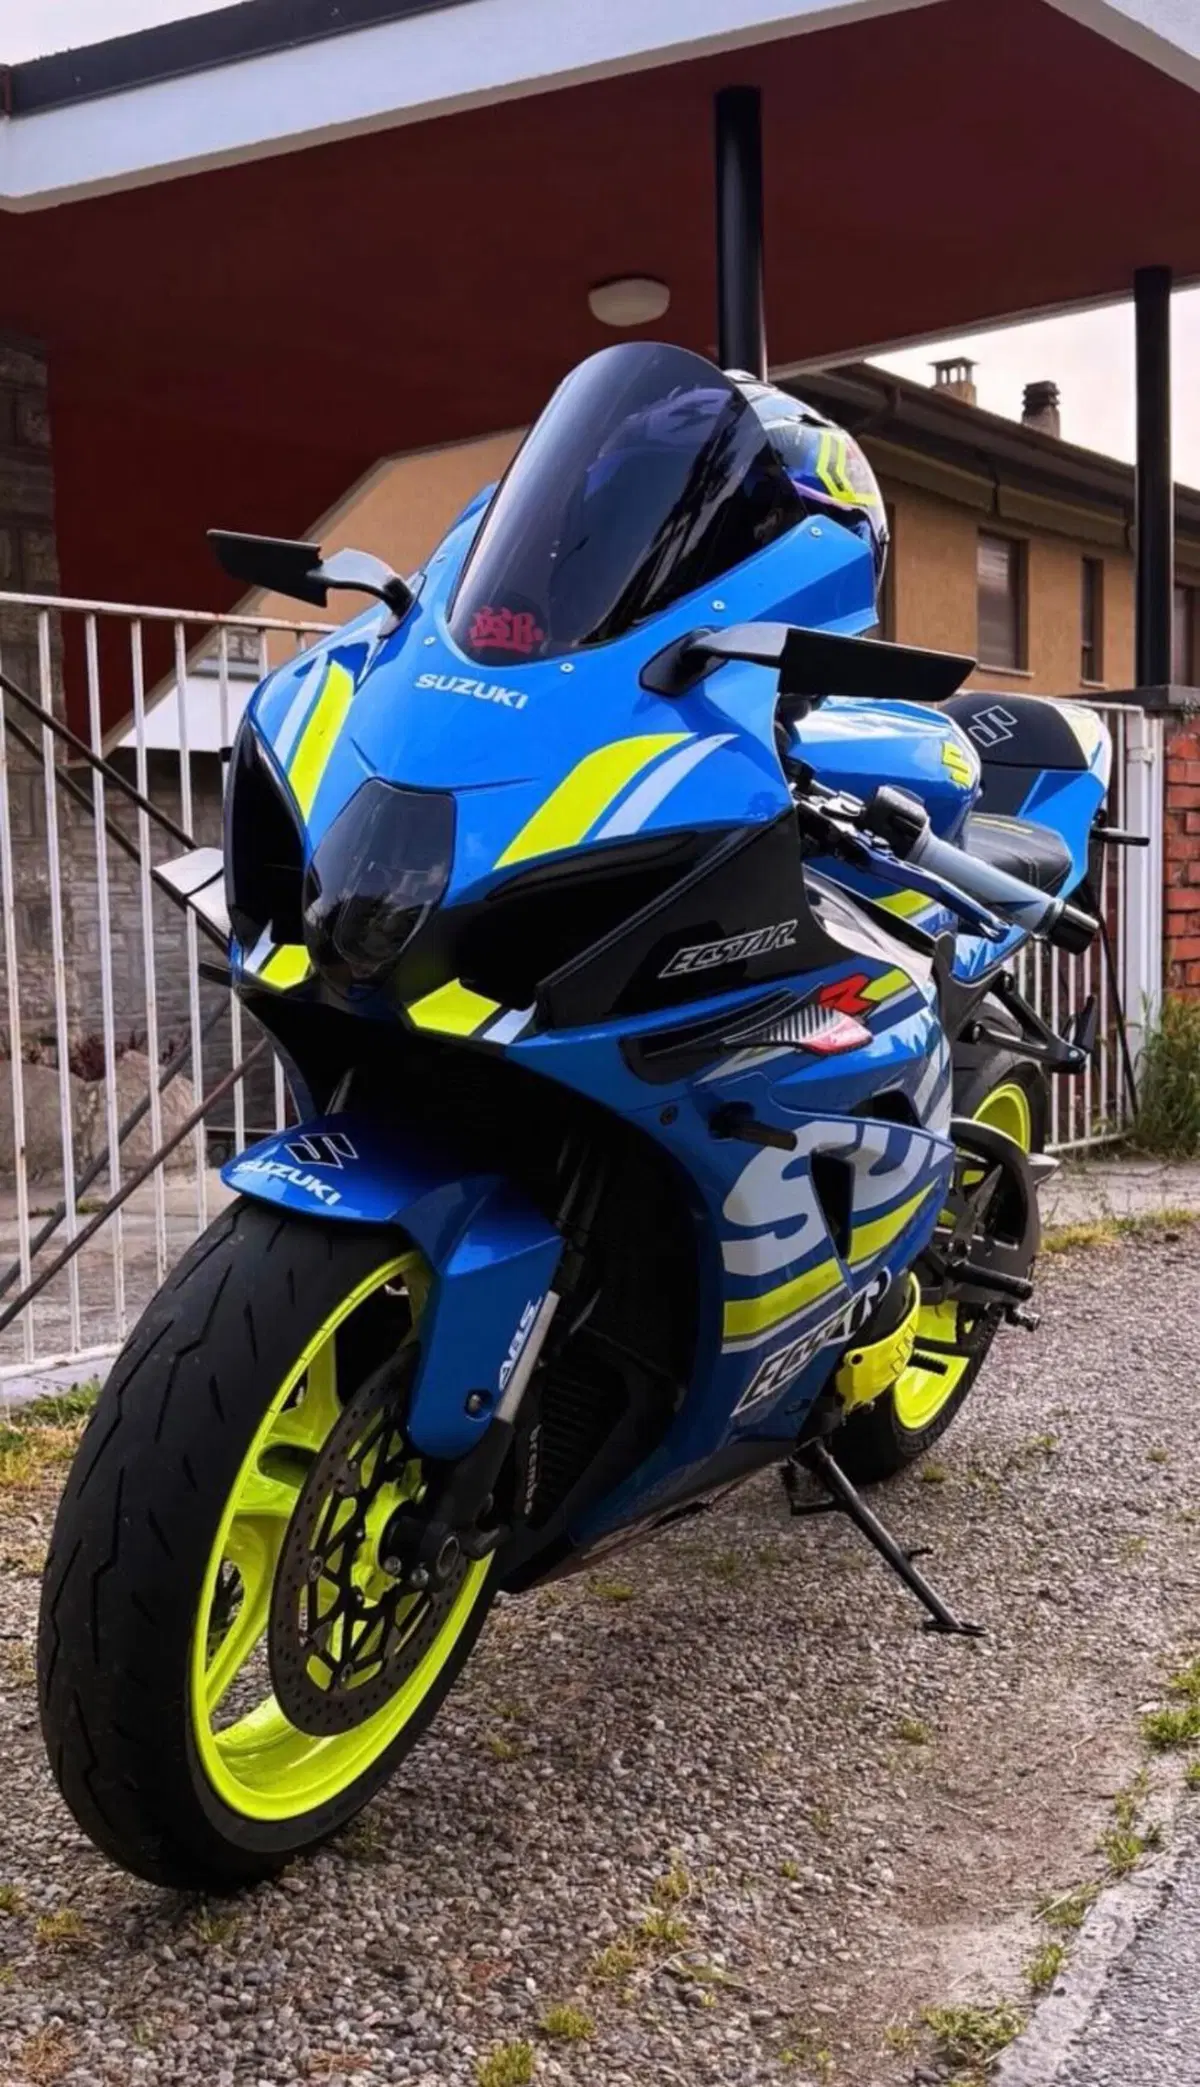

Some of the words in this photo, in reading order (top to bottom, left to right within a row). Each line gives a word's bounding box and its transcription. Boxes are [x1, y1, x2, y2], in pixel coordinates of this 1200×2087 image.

[415, 673, 529, 710] SUZUKI
[658, 919, 799, 979] ECSTAR
[232, 1160, 343, 1206] SUZUKI
[498, 1297, 543, 1391] ABS
